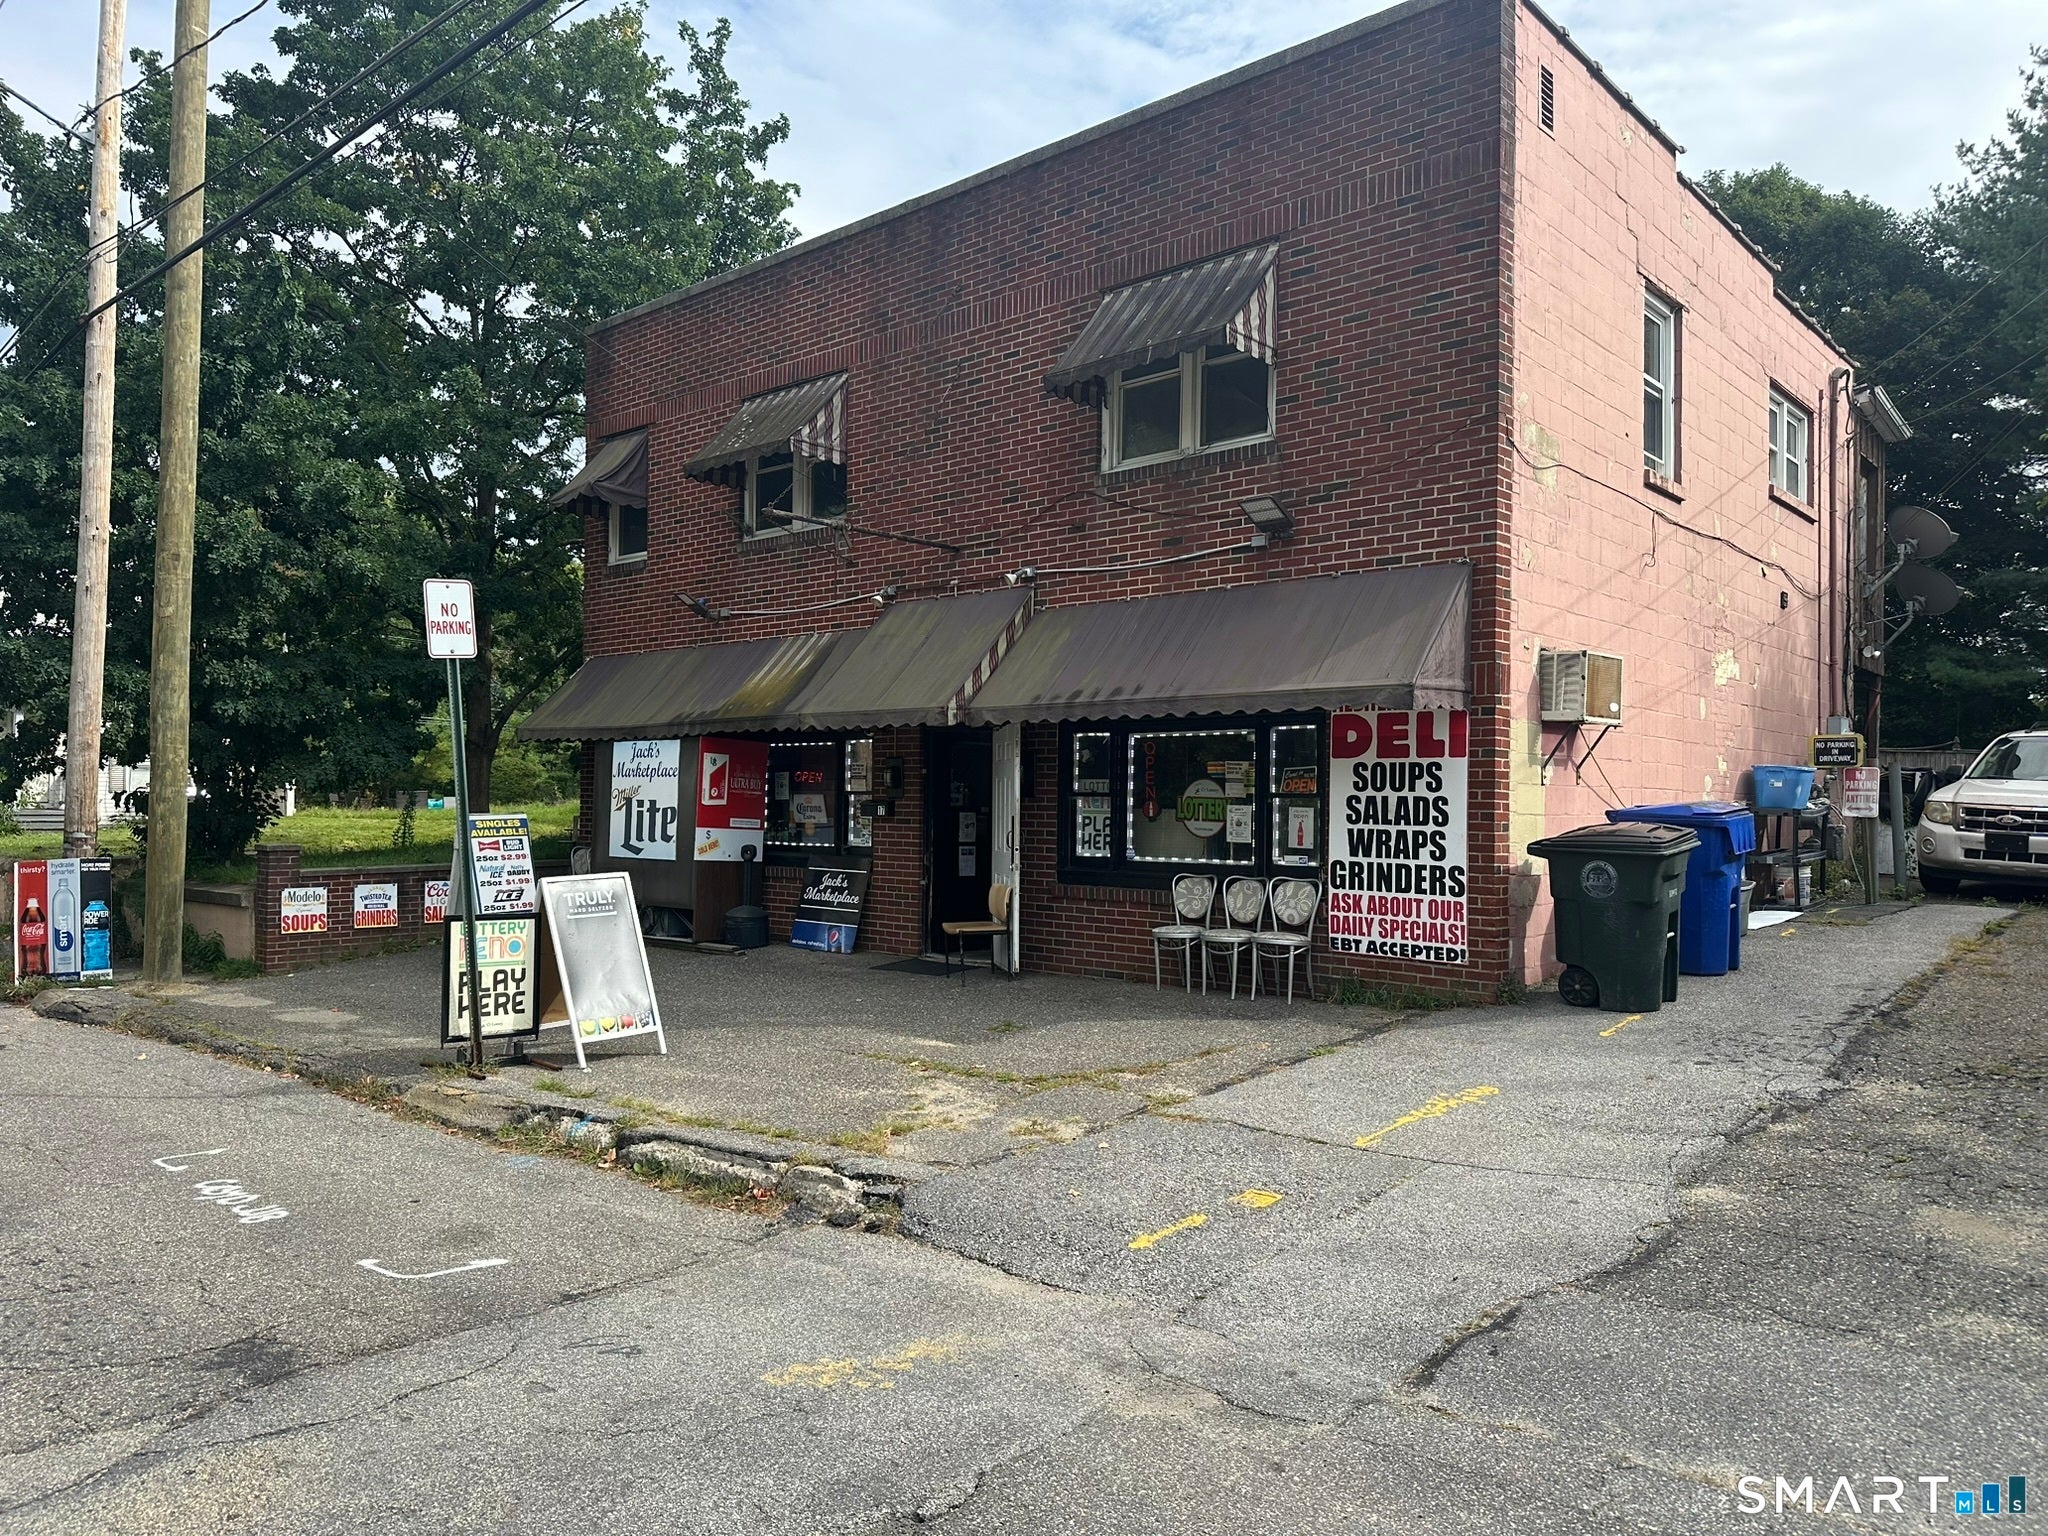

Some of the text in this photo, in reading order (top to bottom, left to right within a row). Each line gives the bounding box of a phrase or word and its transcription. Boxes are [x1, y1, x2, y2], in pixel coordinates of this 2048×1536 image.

[440, 603, 459, 617] NO
[430, 620, 472, 635] PARKING
[1331, 710, 1468, 759] DELI
[630, 742, 660, 763] Jack's
[612, 761, 678, 783] Marketplace
[794, 771, 823, 783] OPEN
[1144, 742, 1156, 799] OPEN
[1352, 761, 1443, 793] SOUPS
[1855, 771, 1866, 780] NO
[730, 777, 749, 789] ULTRA
[1282, 779, 1316, 792] OPEN
[1845, 780, 1878, 789] PARKING
[612, 785, 641, 808] Miller
[1846, 794, 1876, 803] ANYTIME
[796, 803, 822, 815] Corona
[1176, 795, 1232, 822] LOTTERY
[1345, 794, 1449, 827] SALADS
[475, 820, 521, 828] SINGLES
[620, 797, 678, 856] Lite
[1082, 816, 1111, 833] PLA
[471, 828, 528, 837] AVAILABLE!
[1082, 833, 1111, 851] HER
[1347, 828, 1447, 861] WRAPS
[20, 866, 46, 874] thirsty?
[51, 862, 75, 870] hydrate
[479, 864, 506, 873] Natural
[489, 871, 504, 879] ICE
[819, 873, 849, 890] Jack's
[1330, 860, 1466, 898] GRINDERS
[288, 890, 322, 903] Modelo
[360, 893, 392, 902] TWISTED TEA
[427, 883, 449, 898] Coo
[496, 890, 522, 901] ICE
[803, 886, 860, 906] Marketplace
[430, 898, 446, 906] LIG
[509, 902, 534, 910] $1.99
[1330, 893, 1465, 922] ASK ABOUT OUR
[355, 909, 398, 927] GRINDERS
[425, 906, 446, 922] SAL
[59, 914, 68, 947] smart
[282, 913, 327, 932] SOUPS
[460, 921, 527, 936] LTTERY
[1330, 915, 1466, 946] DAILY SPECIALS!
[1330, 937, 1467, 963] EBT ACCEPTED!
[458, 968, 527, 995] PLAY
[458, 991, 526, 1019] HERE
